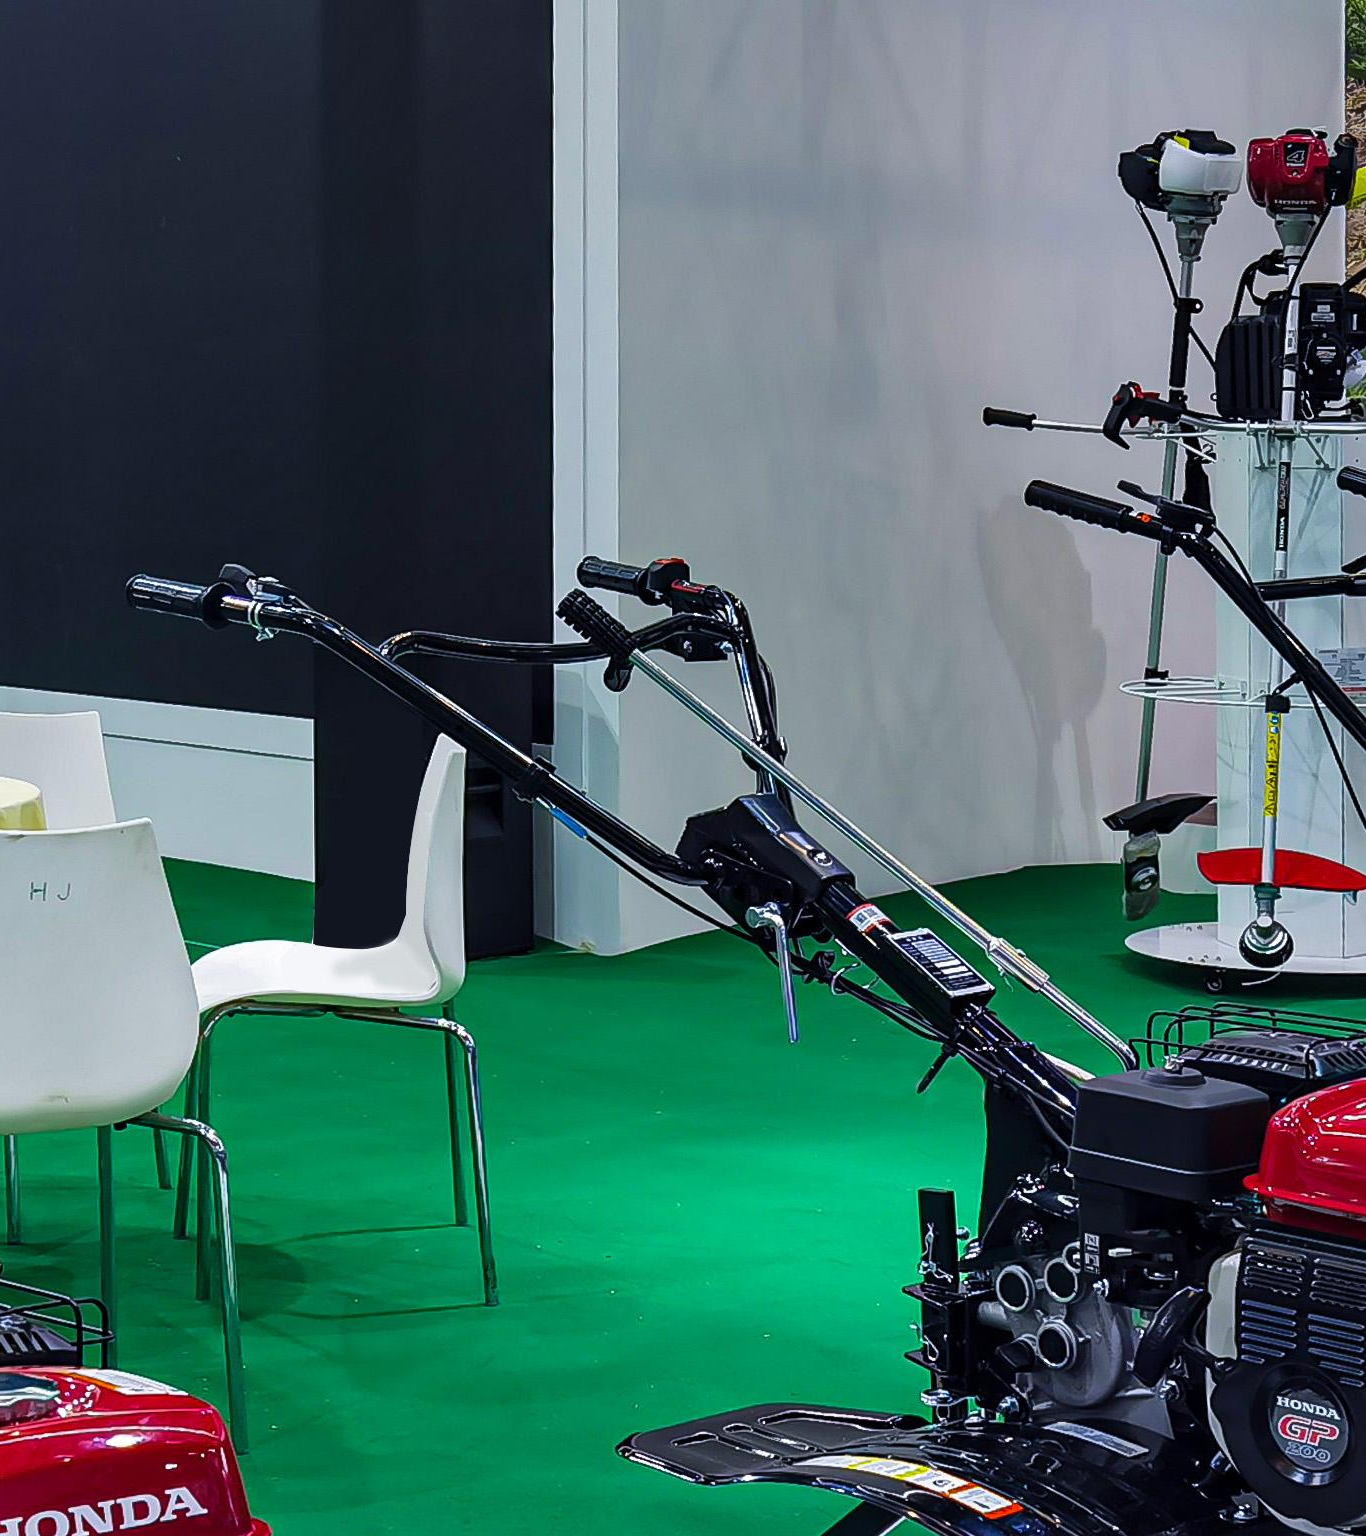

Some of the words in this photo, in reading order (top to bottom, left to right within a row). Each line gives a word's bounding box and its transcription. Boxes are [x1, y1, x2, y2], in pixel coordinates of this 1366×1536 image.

[1276, 1395, 1341, 1421] HONDA
[1278, 1413, 1340, 1447] GP
[1285, 1441, 1331, 1463] 200
